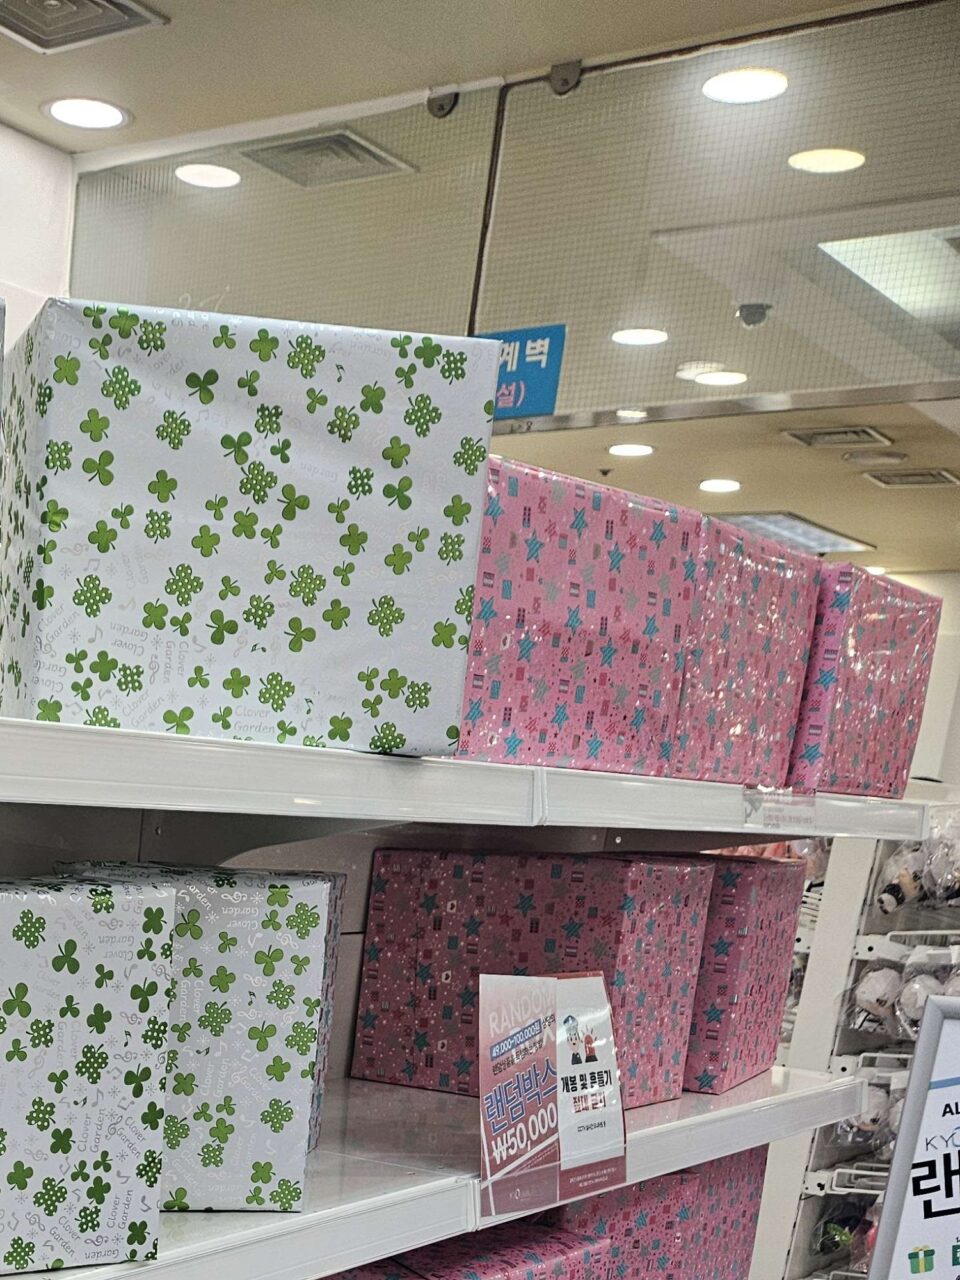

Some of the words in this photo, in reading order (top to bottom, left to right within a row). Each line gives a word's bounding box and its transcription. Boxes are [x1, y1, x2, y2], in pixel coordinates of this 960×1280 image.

[46, 611, 80, 642] Garden
[110, 622, 148, 642] Garden
[112, 638, 145, 657] Clover
[177, 641, 189, 677] Clover
[163, 641, 176, 684] Garden
[234, 704, 270, 718] Clover
[233, 721, 275, 734] Garden
[222, 906, 259, 917] Garden
[227, 919, 259, 930] Clover
[98, 935, 135, 947] Garden
[103, 950, 134, 962] Clover
[489, 988, 555, 1038] RANDOM
[483, 1056, 558, 1136] 랜덤박스
[561, 1075, 578, 1093] 개봉
[579, 1073, 588, 1091] 및
[77, 1113, 91, 1152] Clover
[90, 1108, 106, 1153] Garden
[116, 1127, 142, 1159] Garden
[124, 1116, 146, 1143] Clover
[490, 1102, 557, 1166] ₩50,000
[106, 1193, 120, 1229] Clover
[118, 1189, 133, 1230] Garden
[49, 1227, 75, 1257] Garden
[58, 1215, 81, 1241] Clover
[84, 1249, 119, 1261] Garden
